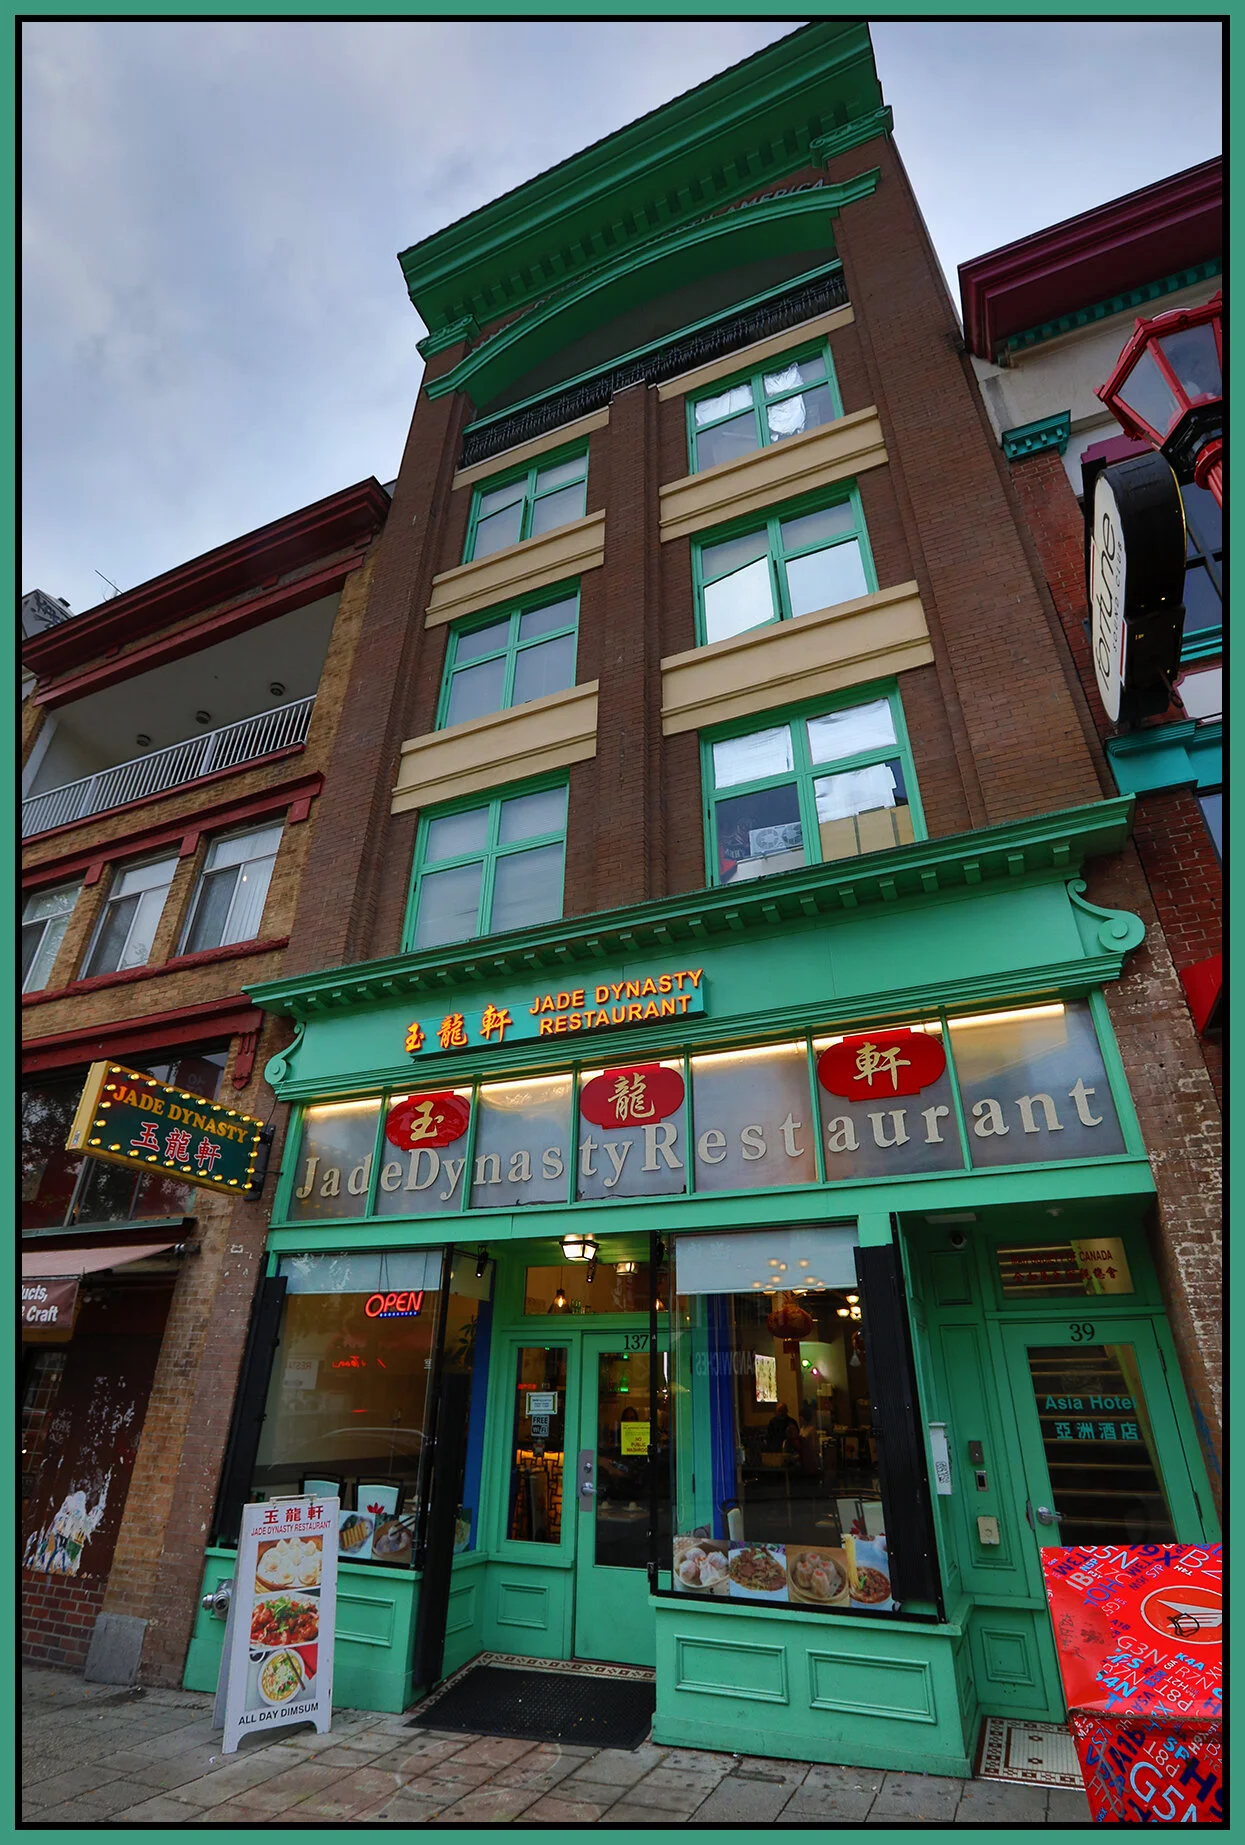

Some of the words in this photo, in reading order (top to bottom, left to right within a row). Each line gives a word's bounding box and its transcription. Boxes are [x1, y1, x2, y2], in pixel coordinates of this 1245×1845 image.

[529, 989, 585, 1015] JADE
[595, 968, 704, 1005] DYNASTY
[539, 994, 692, 1036] RESTAURANT
[404, 1004, 512, 1053] 玉龍軒
[112, 1085, 164, 1116] JADE
[167, 1103, 249, 1144] DYNASTY
[130, 1121, 222, 1171] 玉龍軒
[1079, 1249, 1113, 1262] CANADA
[26, 1305, 59, 1322] Craft
[365, 1291, 424, 1318] OPEN
[624, 1334, 649, 1350] 137
[1069, 1322, 1095, 1342] 39
[1045, 1395, 1084, 1410] Asia
[1089, 1395, 1137, 1410] Hotel
[532, 1416, 548, 1425] FREE
[1054, 1421, 1139, 1441] 亞洲酒店
[263, 1505, 323, 1525] 玉龍軒
[251, 1527, 267, 1536] JADE
[267, 1524, 293, 1535] DYNASTY
[295, 1520, 331, 1532] RESTAURANT
[238, 1714, 257, 1725] ALL
[259, 1710, 279, 1721] DAY
[281, 1702, 319, 1717] DIMSUM
